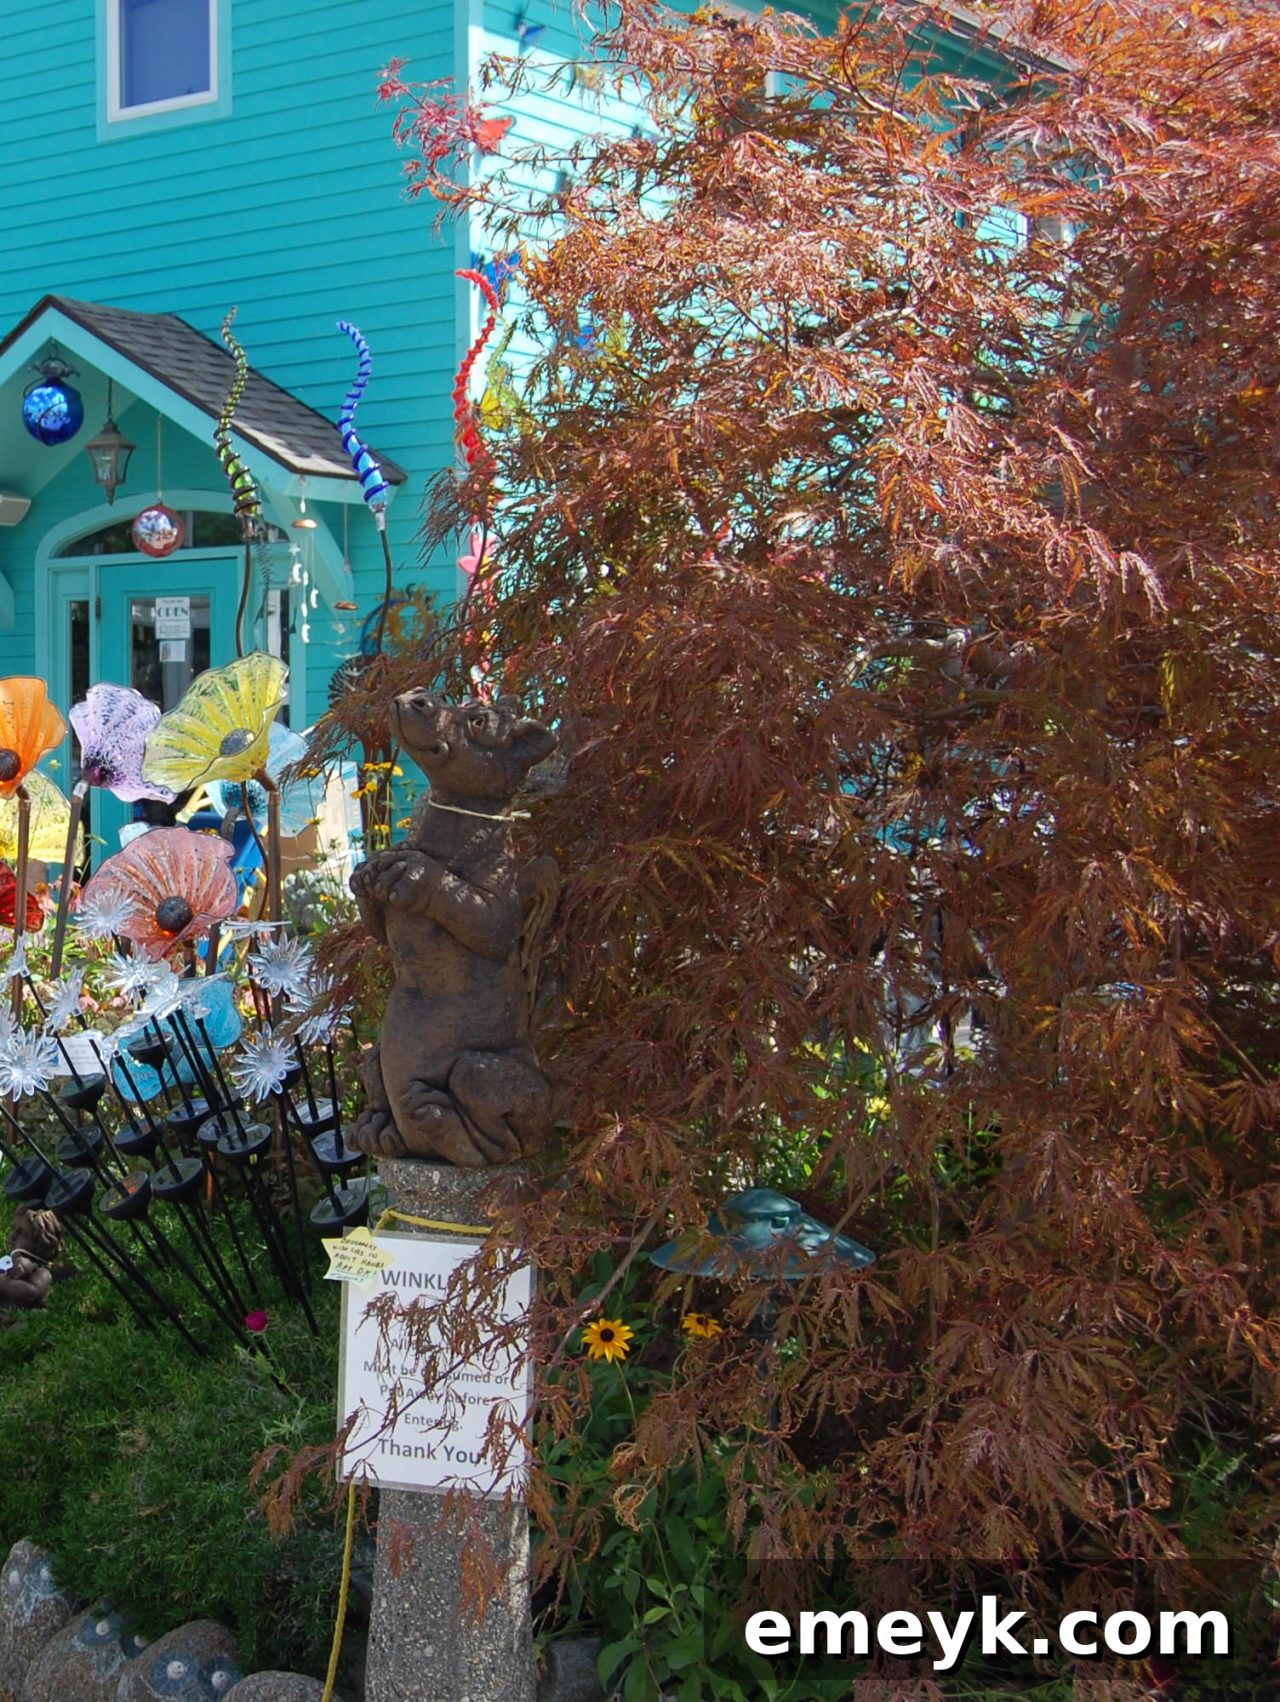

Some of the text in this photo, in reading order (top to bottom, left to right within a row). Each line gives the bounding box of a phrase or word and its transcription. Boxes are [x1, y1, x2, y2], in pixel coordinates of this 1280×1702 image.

[157, 607, 189, 617] OPEN
[495, 1373, 510, 1385] or
[378, 1438, 437, 1461] Thank
